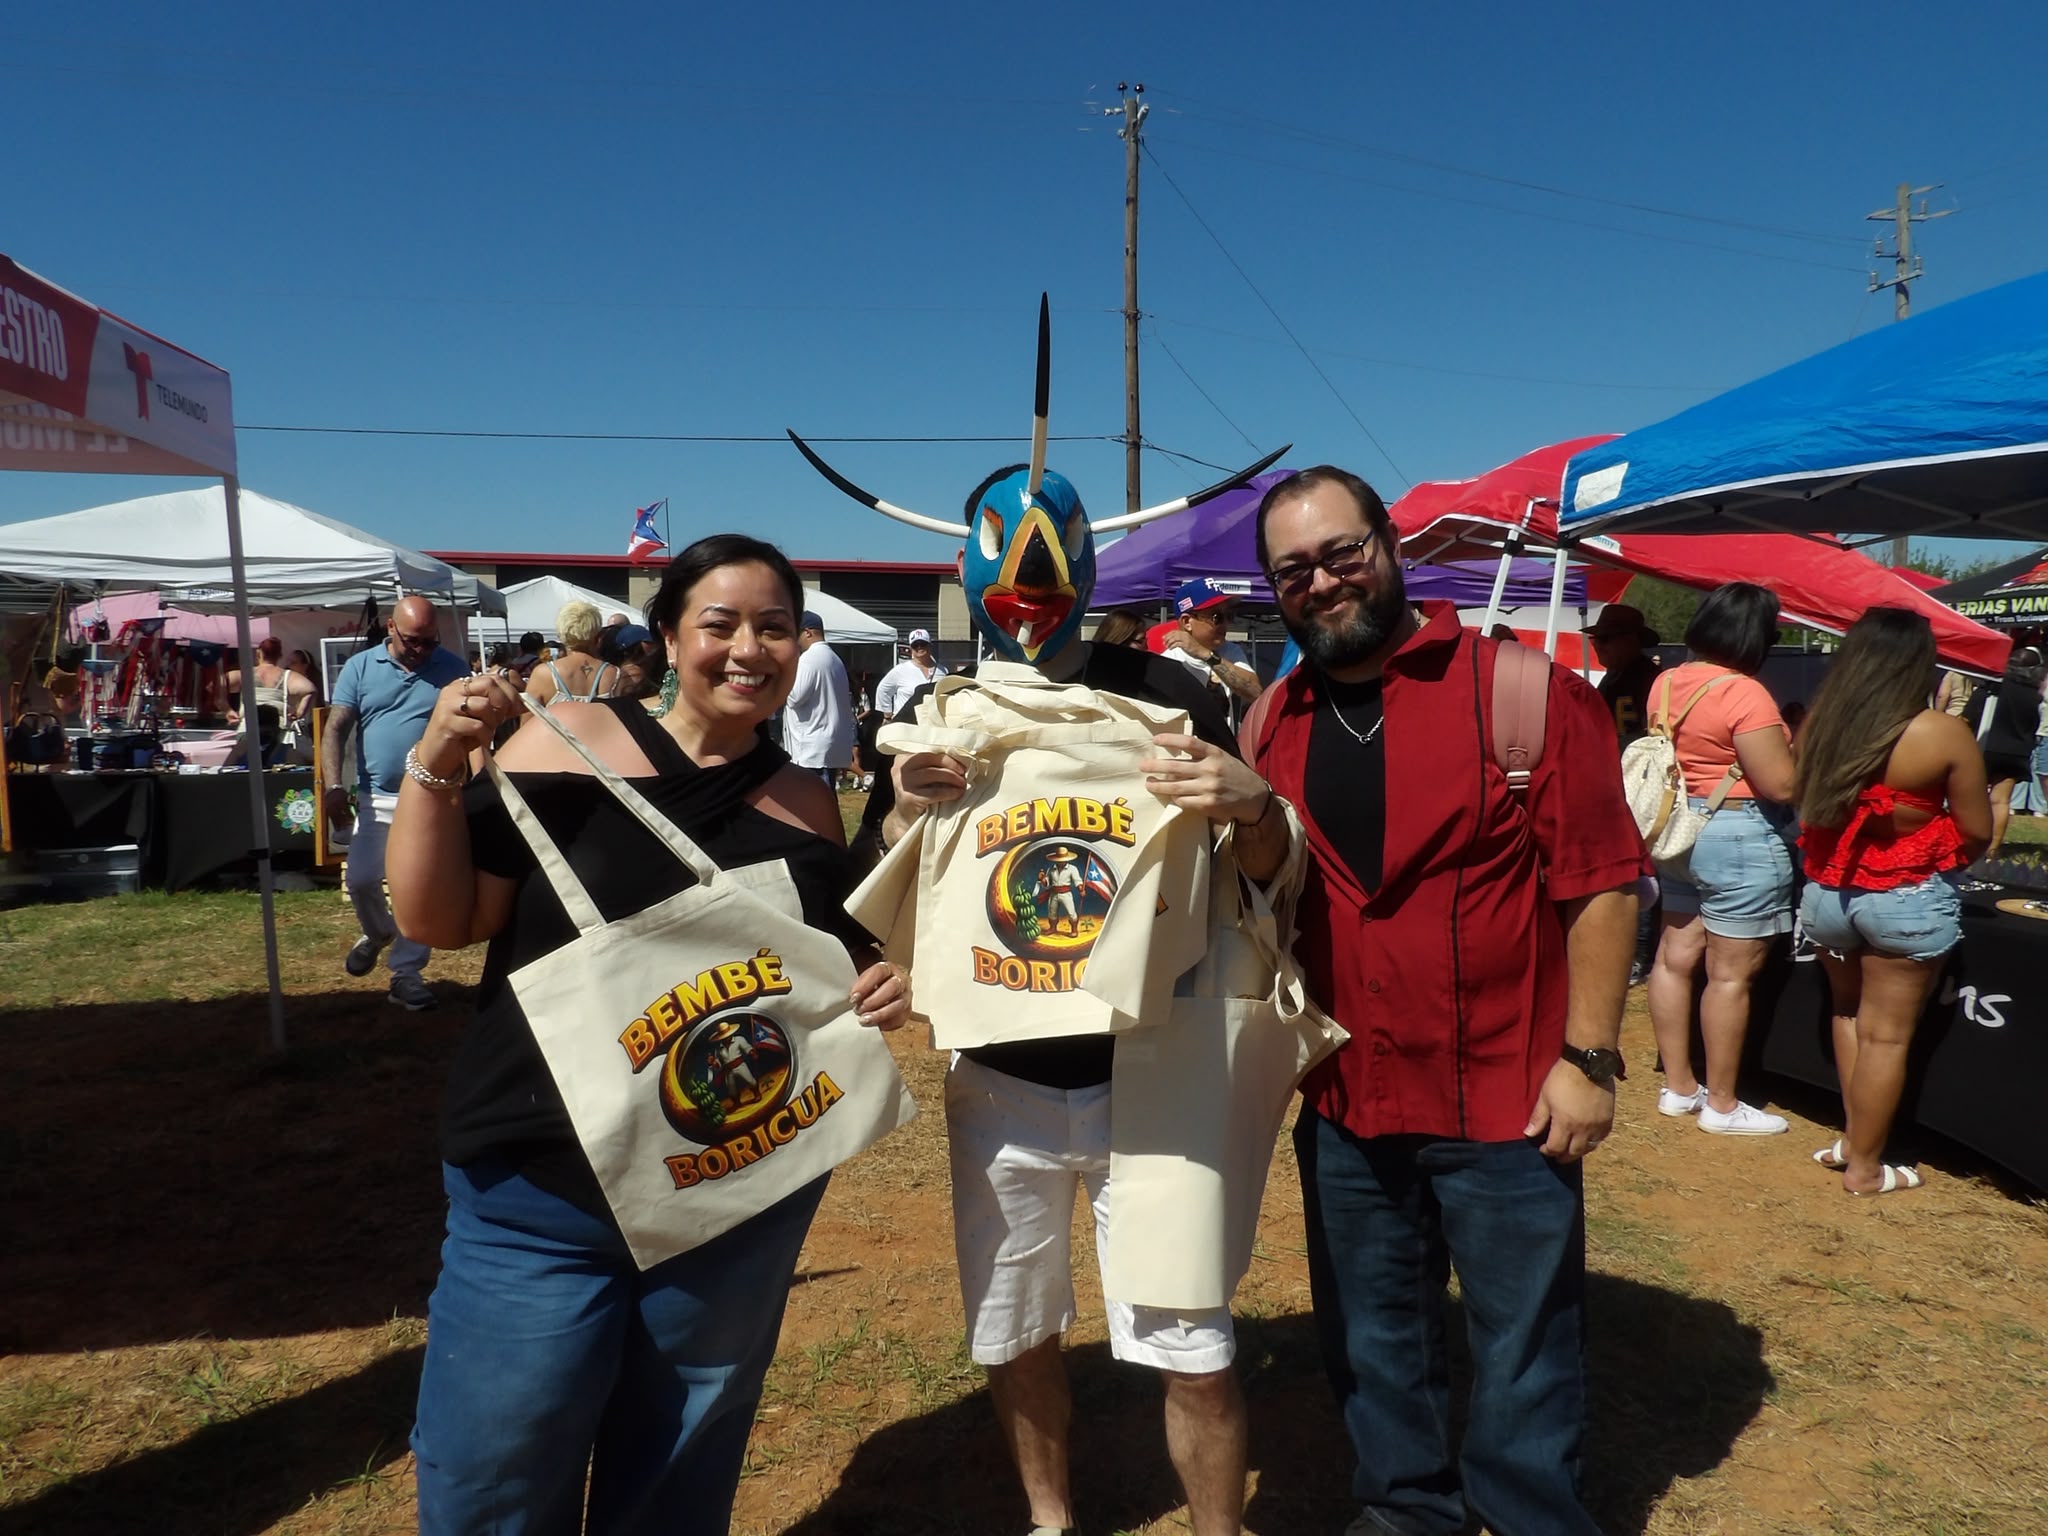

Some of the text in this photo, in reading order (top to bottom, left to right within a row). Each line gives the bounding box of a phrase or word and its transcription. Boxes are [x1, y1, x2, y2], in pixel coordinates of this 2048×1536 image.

[156, 384, 208, 423] TELEMUNDO
[976, 797, 1136, 858] BEMBÉ
[618, 948, 792, 1074] BEMBÉ
[663, 1071, 845, 1190] BORICUA
